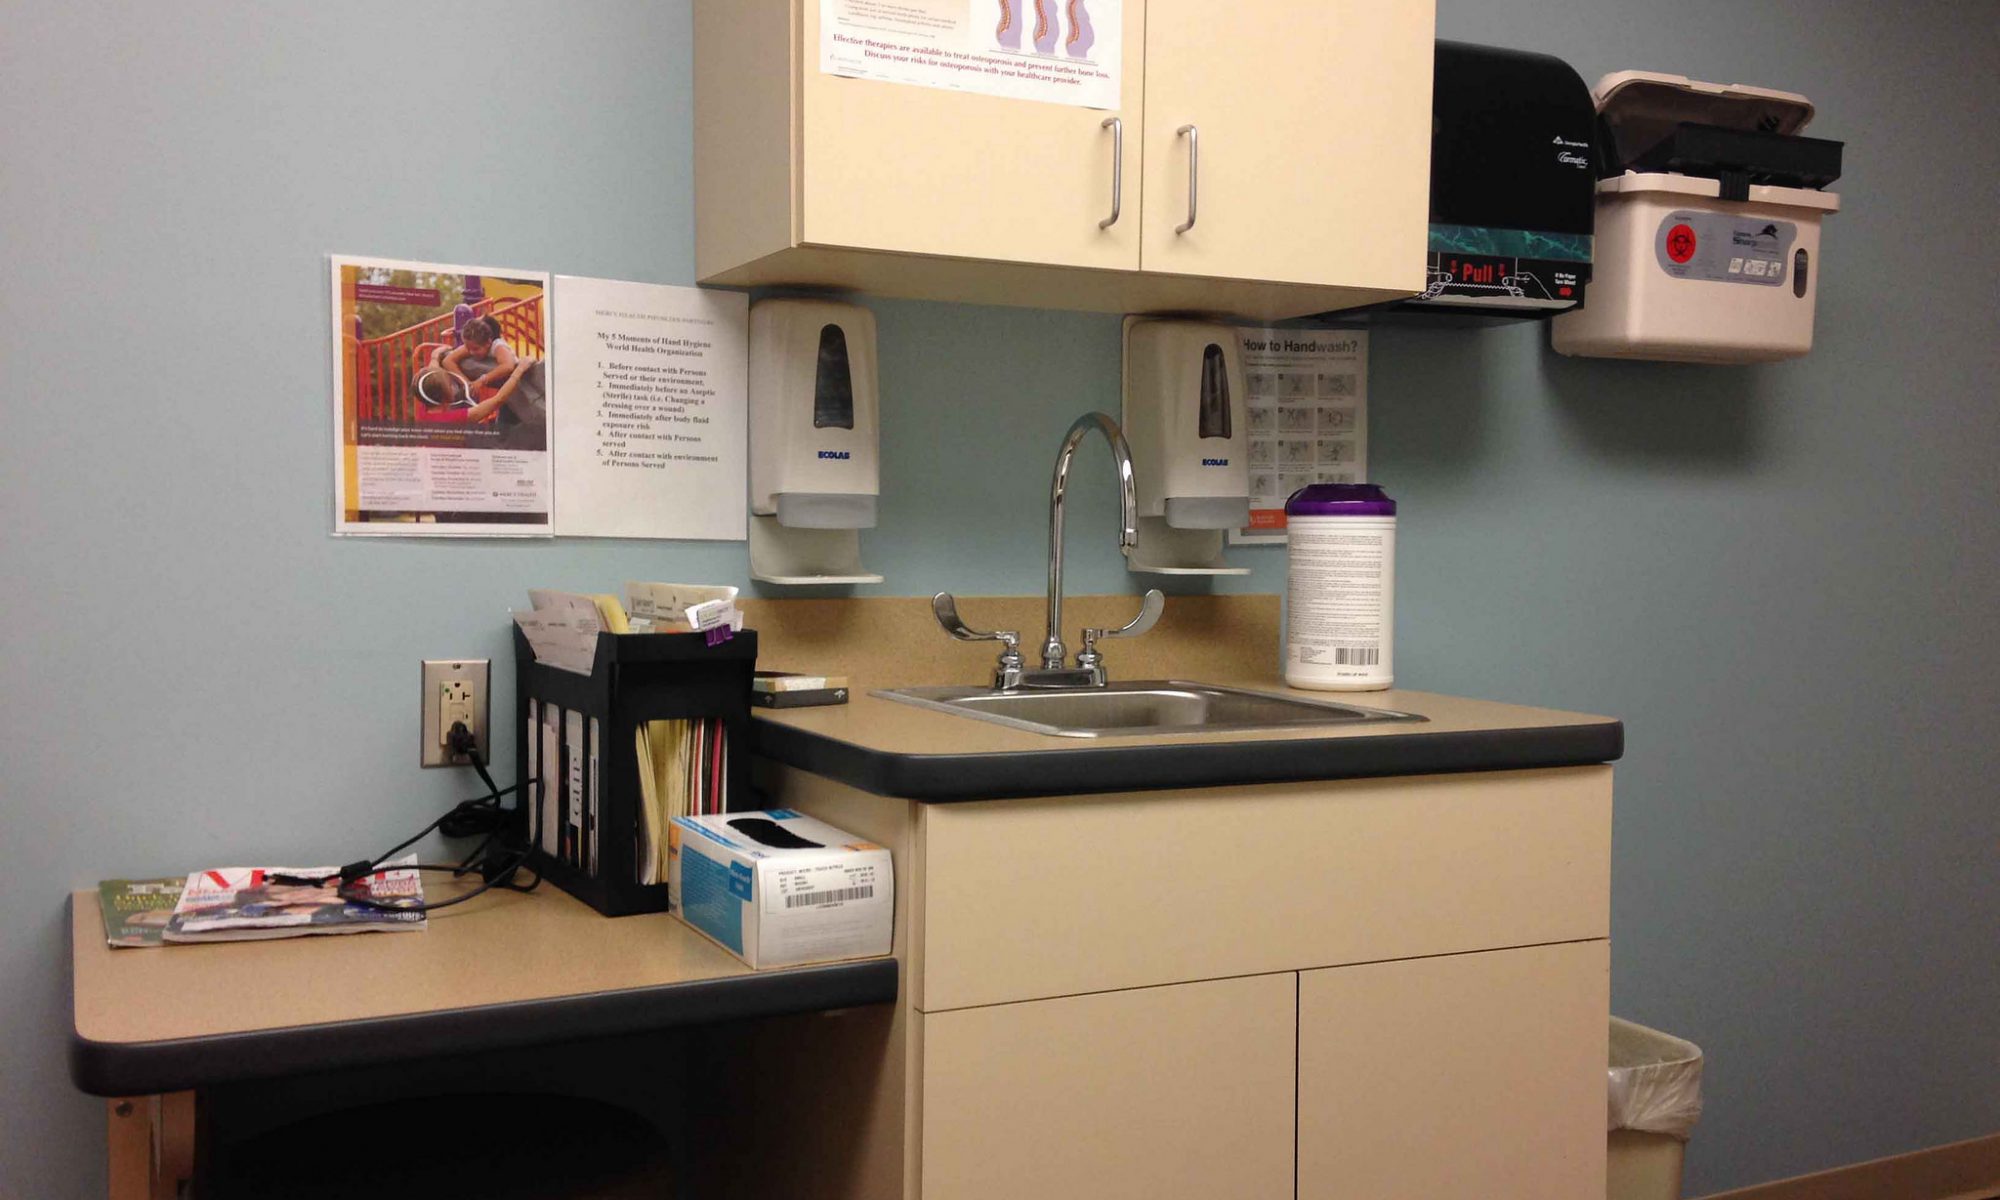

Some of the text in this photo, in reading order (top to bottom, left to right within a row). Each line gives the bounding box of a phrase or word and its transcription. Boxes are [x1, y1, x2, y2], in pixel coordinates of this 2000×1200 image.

[833, 34, 863, 45] Effective
[865, 38, 897, 51] therapies
[912, 46, 942, 56] available
[954, 51, 969, 60] treat
[970, 56, 1012, 66] osteoporosis
[1014, 60, 1026, 68] and
[1028, 62, 1053, 72] prevent
[1054, 65, 1077, 74] further
[1078, 68, 1094, 76] bone
[864, 50, 892, 60] Discuss
[893, 55, 909, 63] your
[928, 58, 938, 66] for
[940, 62, 982, 72] osteoporosis
[1017, 71, 1052, 81] healthcare
[1462, 263, 1492, 282] Pull
[598, 332, 609, 340] My
[618, 334, 651, 342] Moments
[653, 336, 660, 344] of
[661, 337, 681, 346] Hand
[683, 338, 711, 348] Hygiene
[1244, 339, 1358, 352] How to Handwash?
[606, 343, 702, 357] World Health Organization
[609, 363, 632, 371] Before
[603, 372, 628, 380] Served
[609, 382, 653, 392] Immediately
[690, 388, 715, 396] Aseptic
[602, 392, 632, 400] (Sterile)
[665, 396, 699, 405] Changing
[602, 402, 632, 410] dressing
[608, 411, 653, 421] Immediately
[602, 422, 634, 430] exposure
[674, 454, 718, 462] environment
[818, 451, 850, 459] ECOLAB
[1203, 458, 1228, 466] ECOLAB
